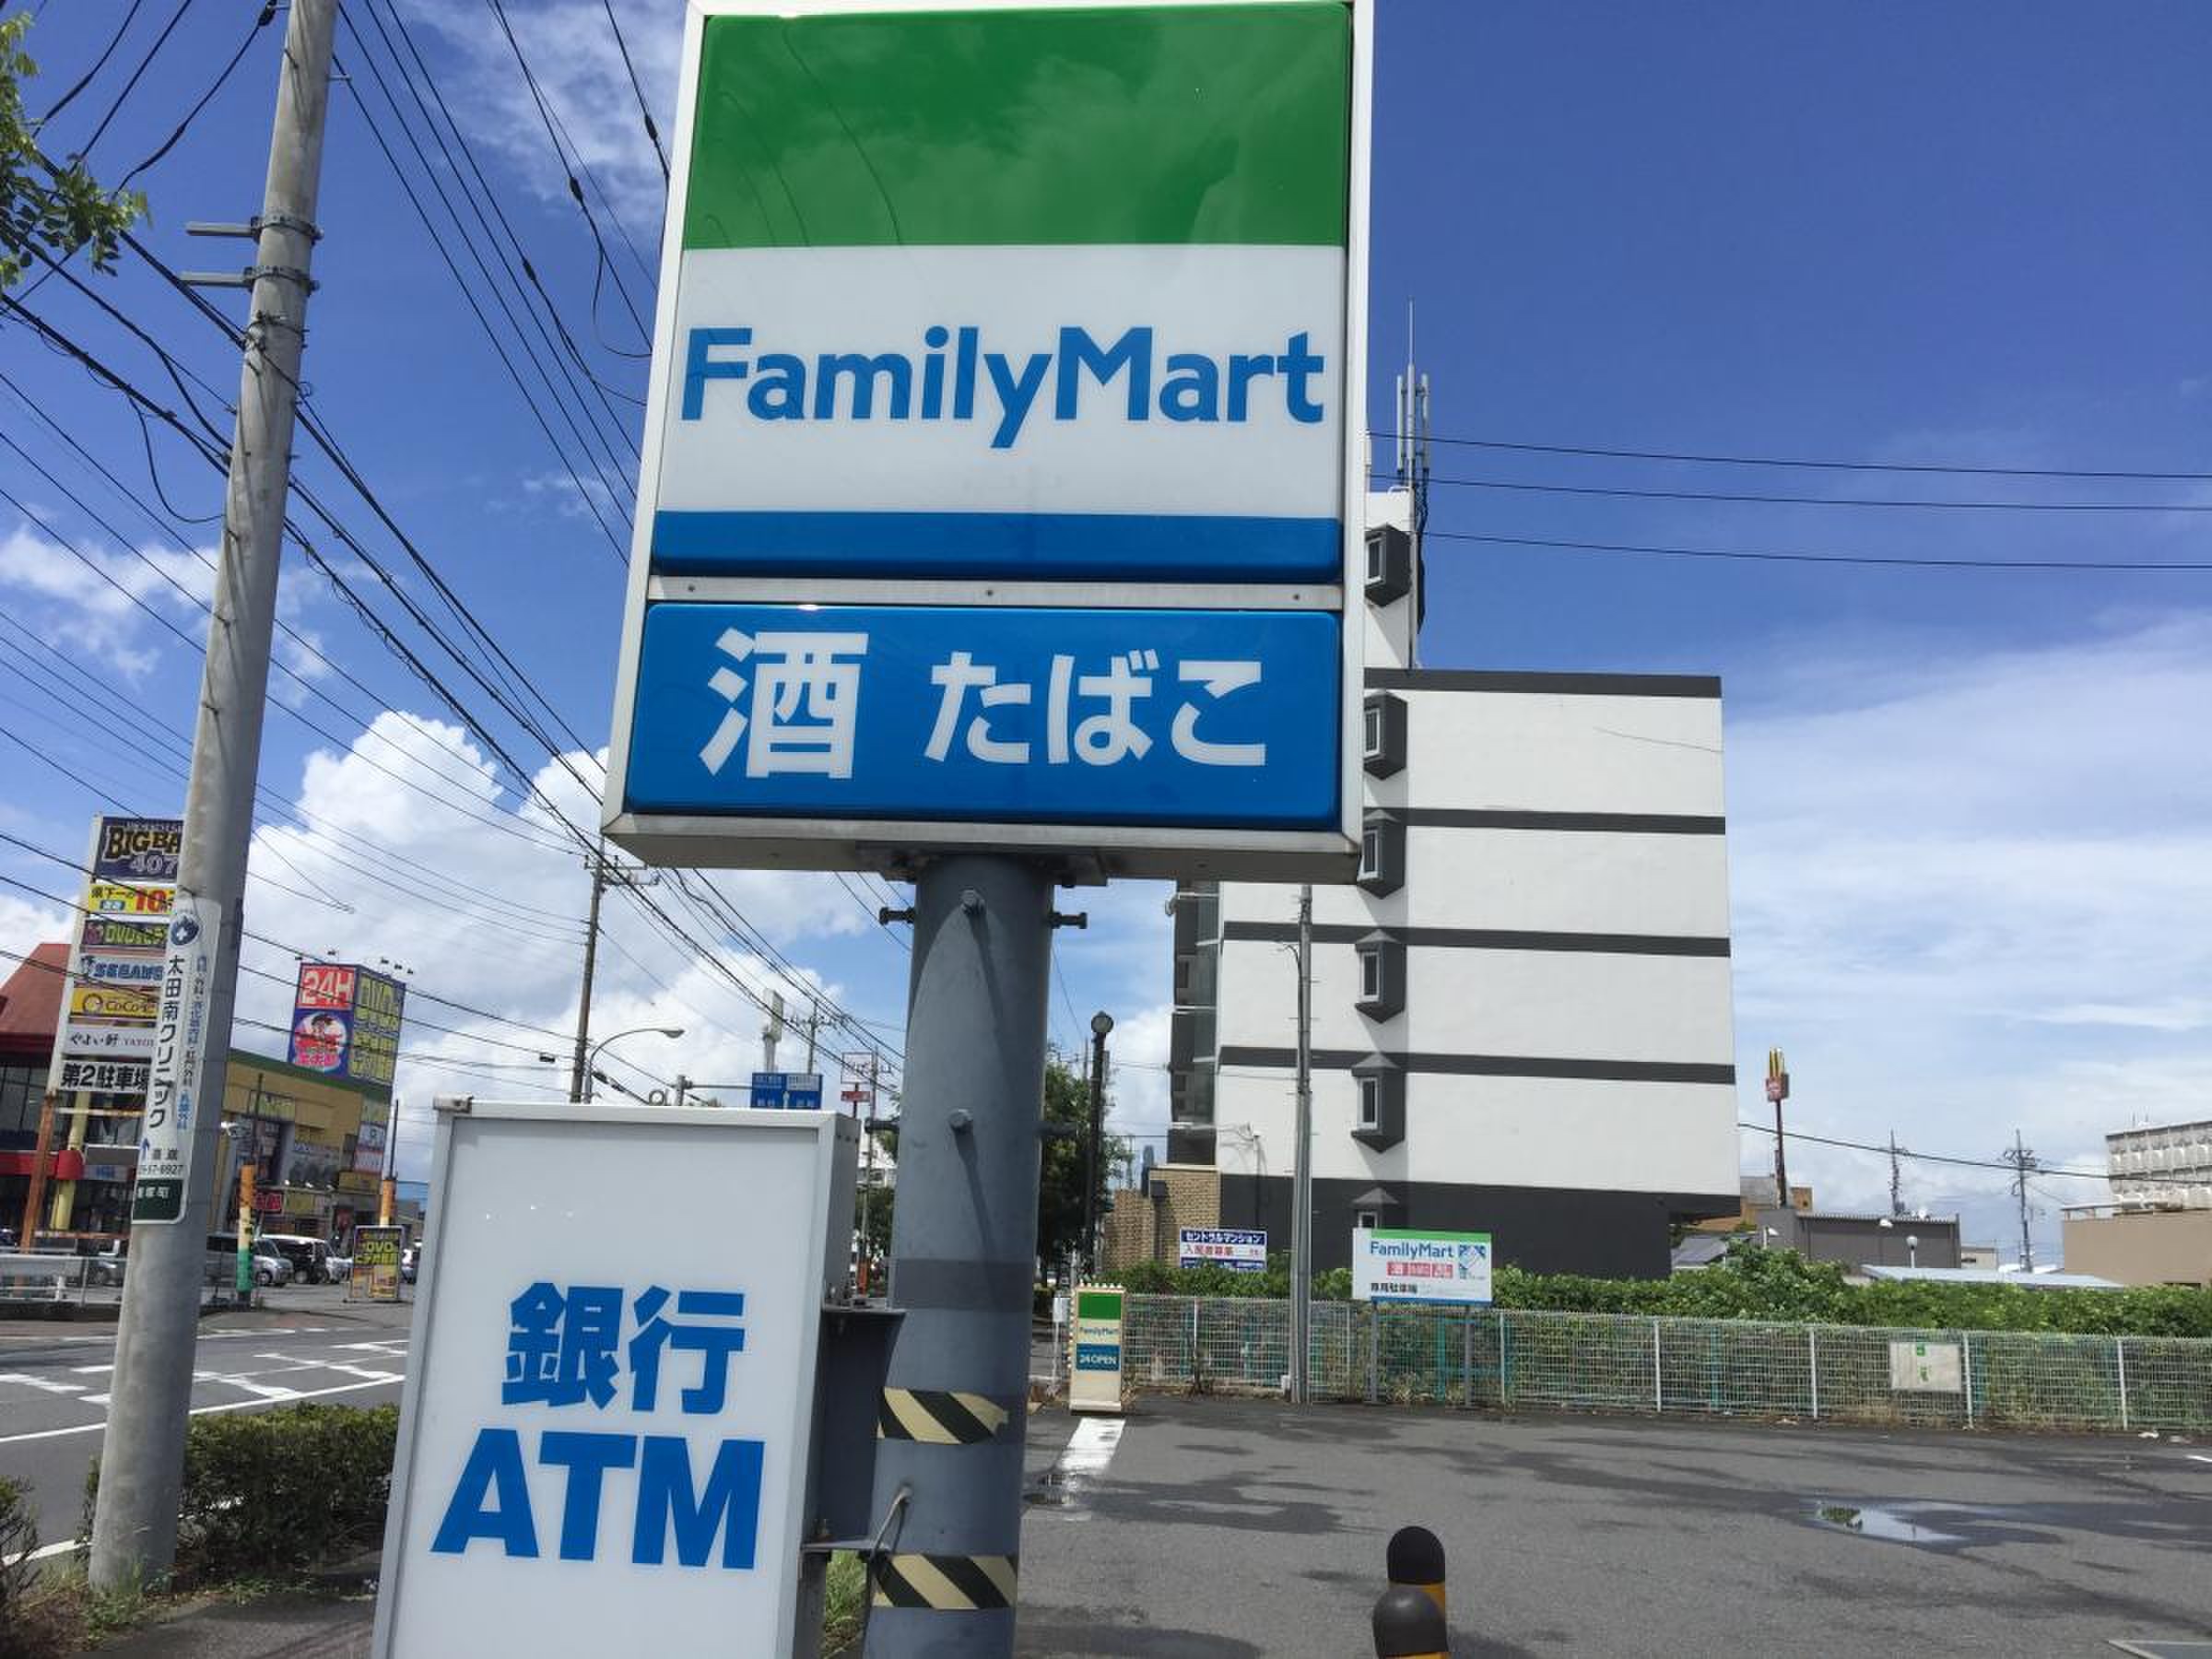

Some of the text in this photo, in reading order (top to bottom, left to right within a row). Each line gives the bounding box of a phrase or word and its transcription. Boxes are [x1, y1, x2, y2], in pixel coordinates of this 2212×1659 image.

[681, 326, 1324, 448] FamilyMart
[700, 628, 1266, 779] 酒 たばこ
[147, 954, 185, 1129] 太田南クリニック
[299, 971, 354, 1005] 24H
[61, 1063, 149, 1091] 第2駐車場
[1371, 1241, 1454, 1259] FamilyMart
[501, 1282, 745, 1415] 銀行
[430, 1428, 765, 1570] ATM
